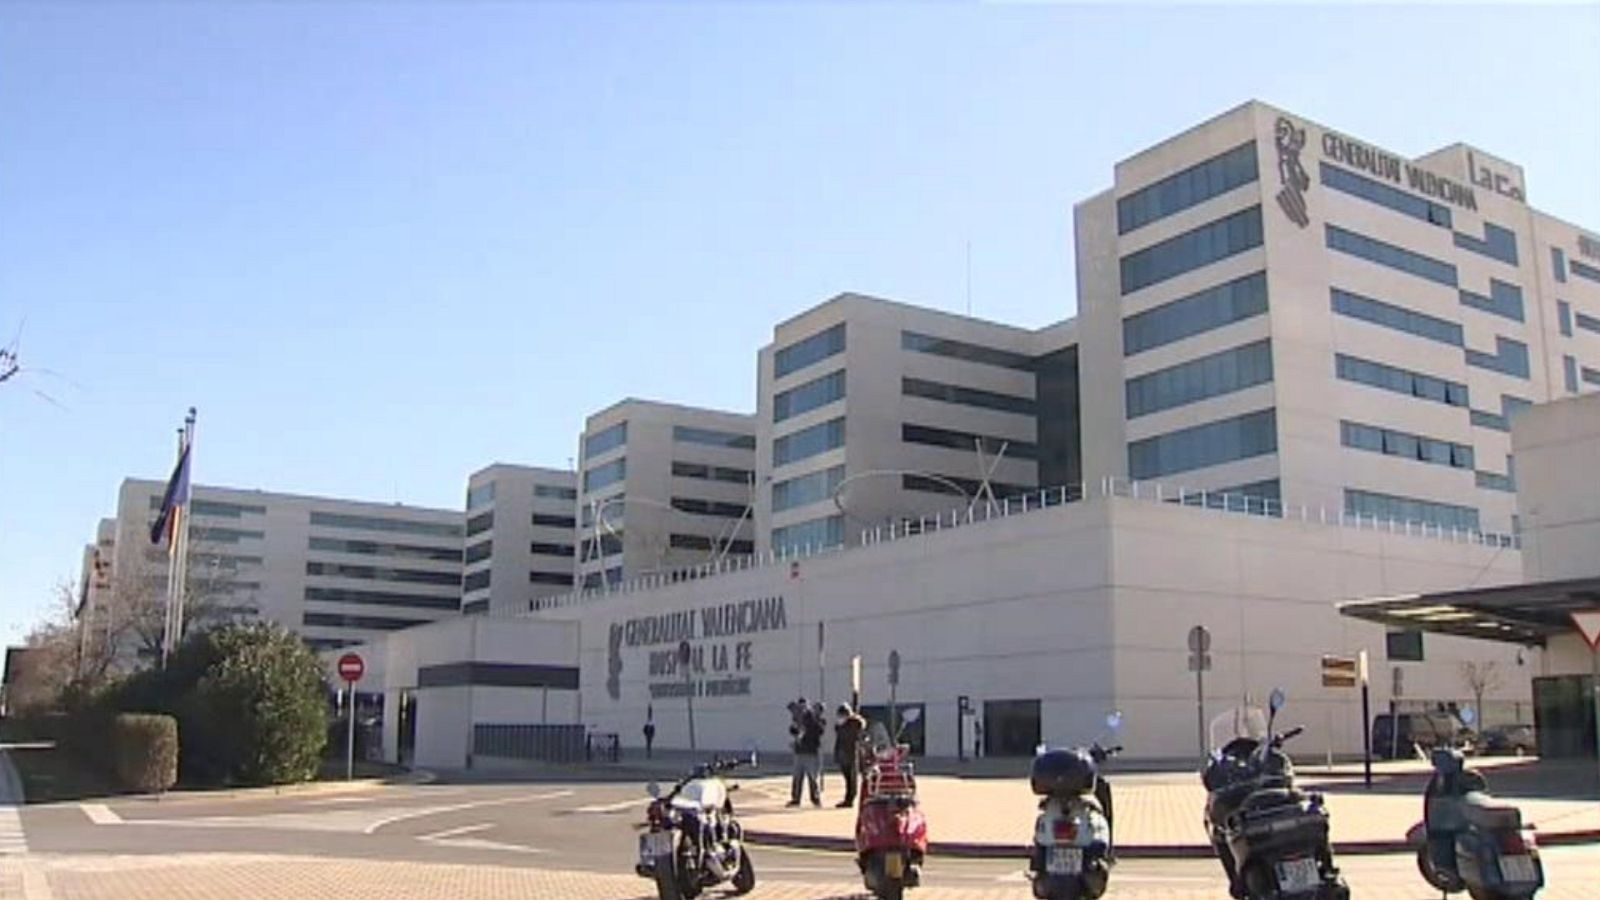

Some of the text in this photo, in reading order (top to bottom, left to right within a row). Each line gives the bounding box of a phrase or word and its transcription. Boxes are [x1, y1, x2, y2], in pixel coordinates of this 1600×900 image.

[1322, 132, 1401, 183] GENERALITAT
[625, 596, 787, 646] GENERALITAT VALENCIANA
[649, 641, 752, 676] HOSPAL LA FE
